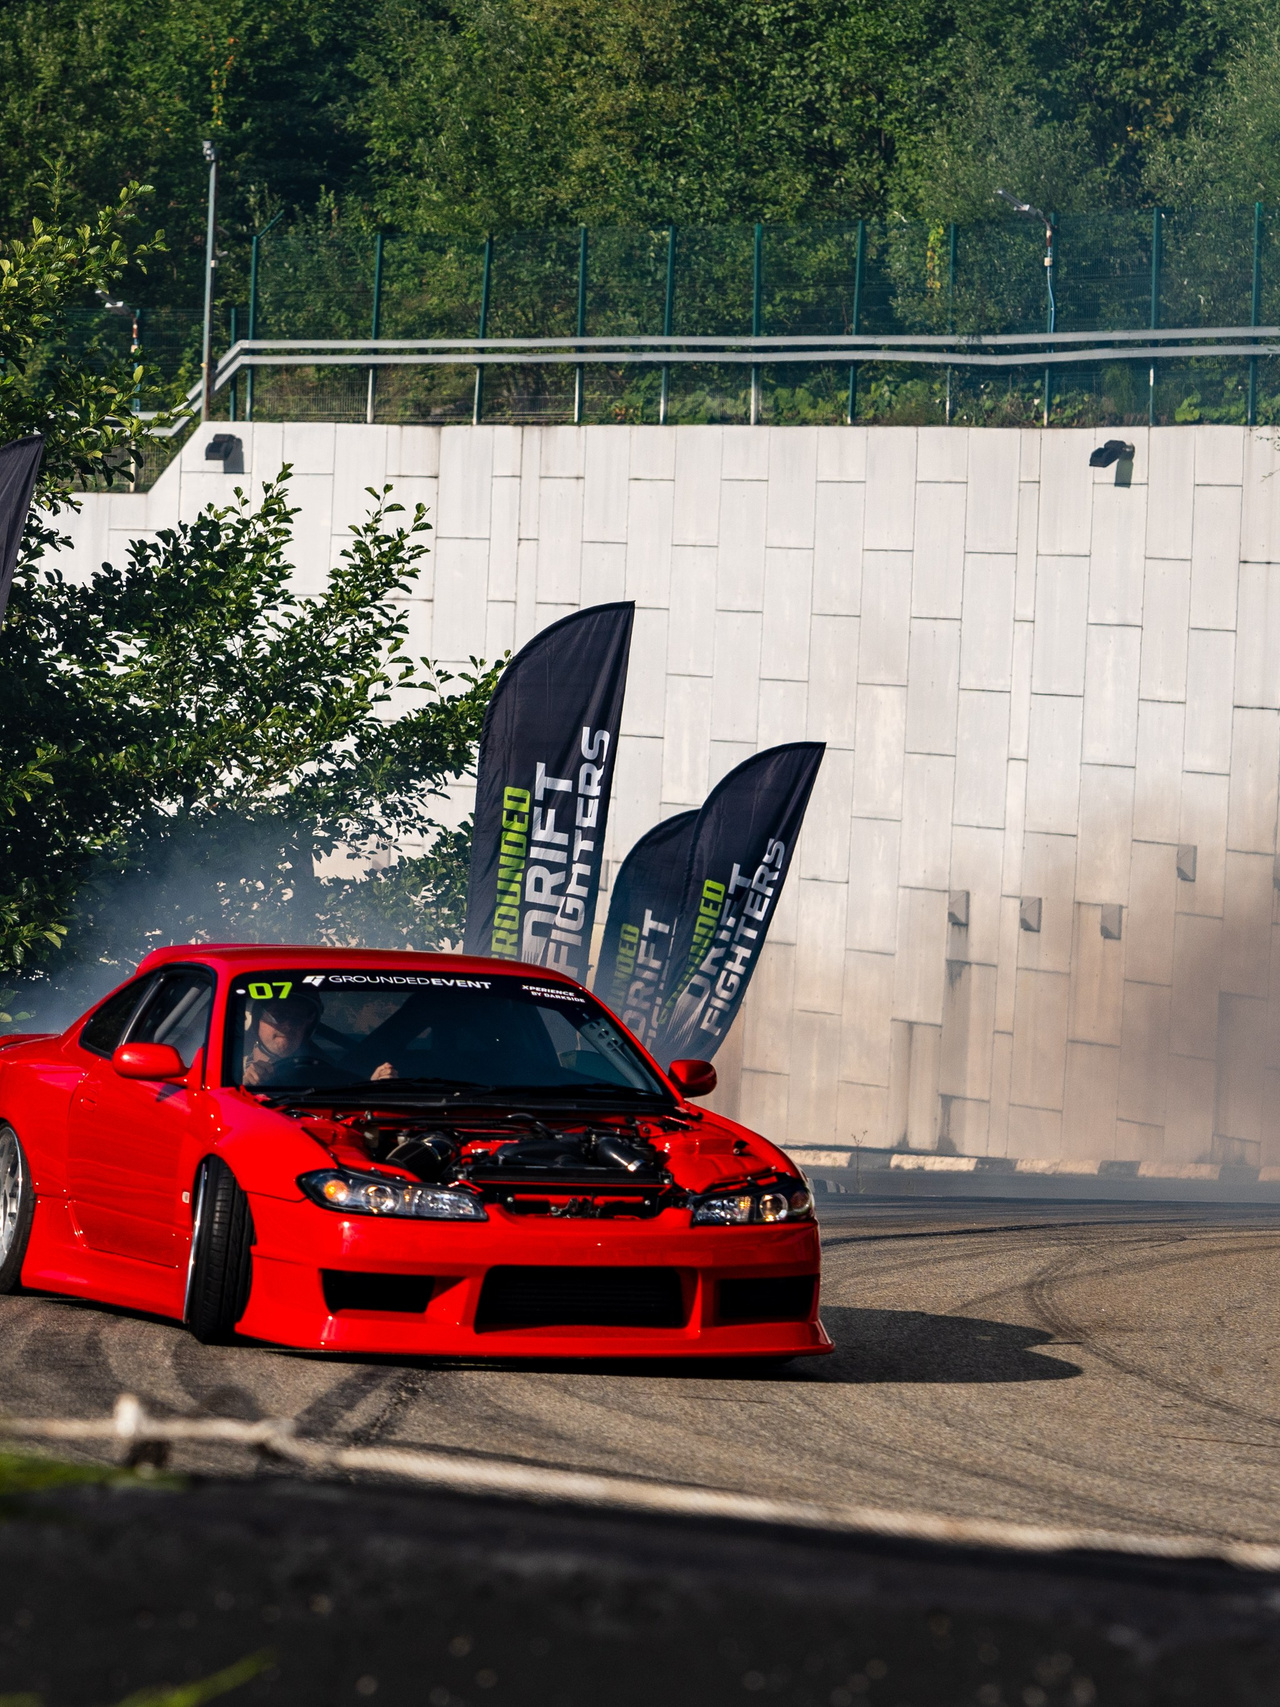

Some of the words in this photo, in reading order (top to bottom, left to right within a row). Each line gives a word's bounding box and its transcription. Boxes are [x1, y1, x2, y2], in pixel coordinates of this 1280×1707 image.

[491, 786, 531, 960] ROUNDED
[521, 762, 573, 965] DRIFT
[546, 727, 610, 978] FIGHTERS
[700, 838, 785, 1036] FIGHTERS
[248, 982, 293, 999] 07
[522, 985, 574, 997] XPERIENCE
[622, 909, 670, 1044] DRIFT
